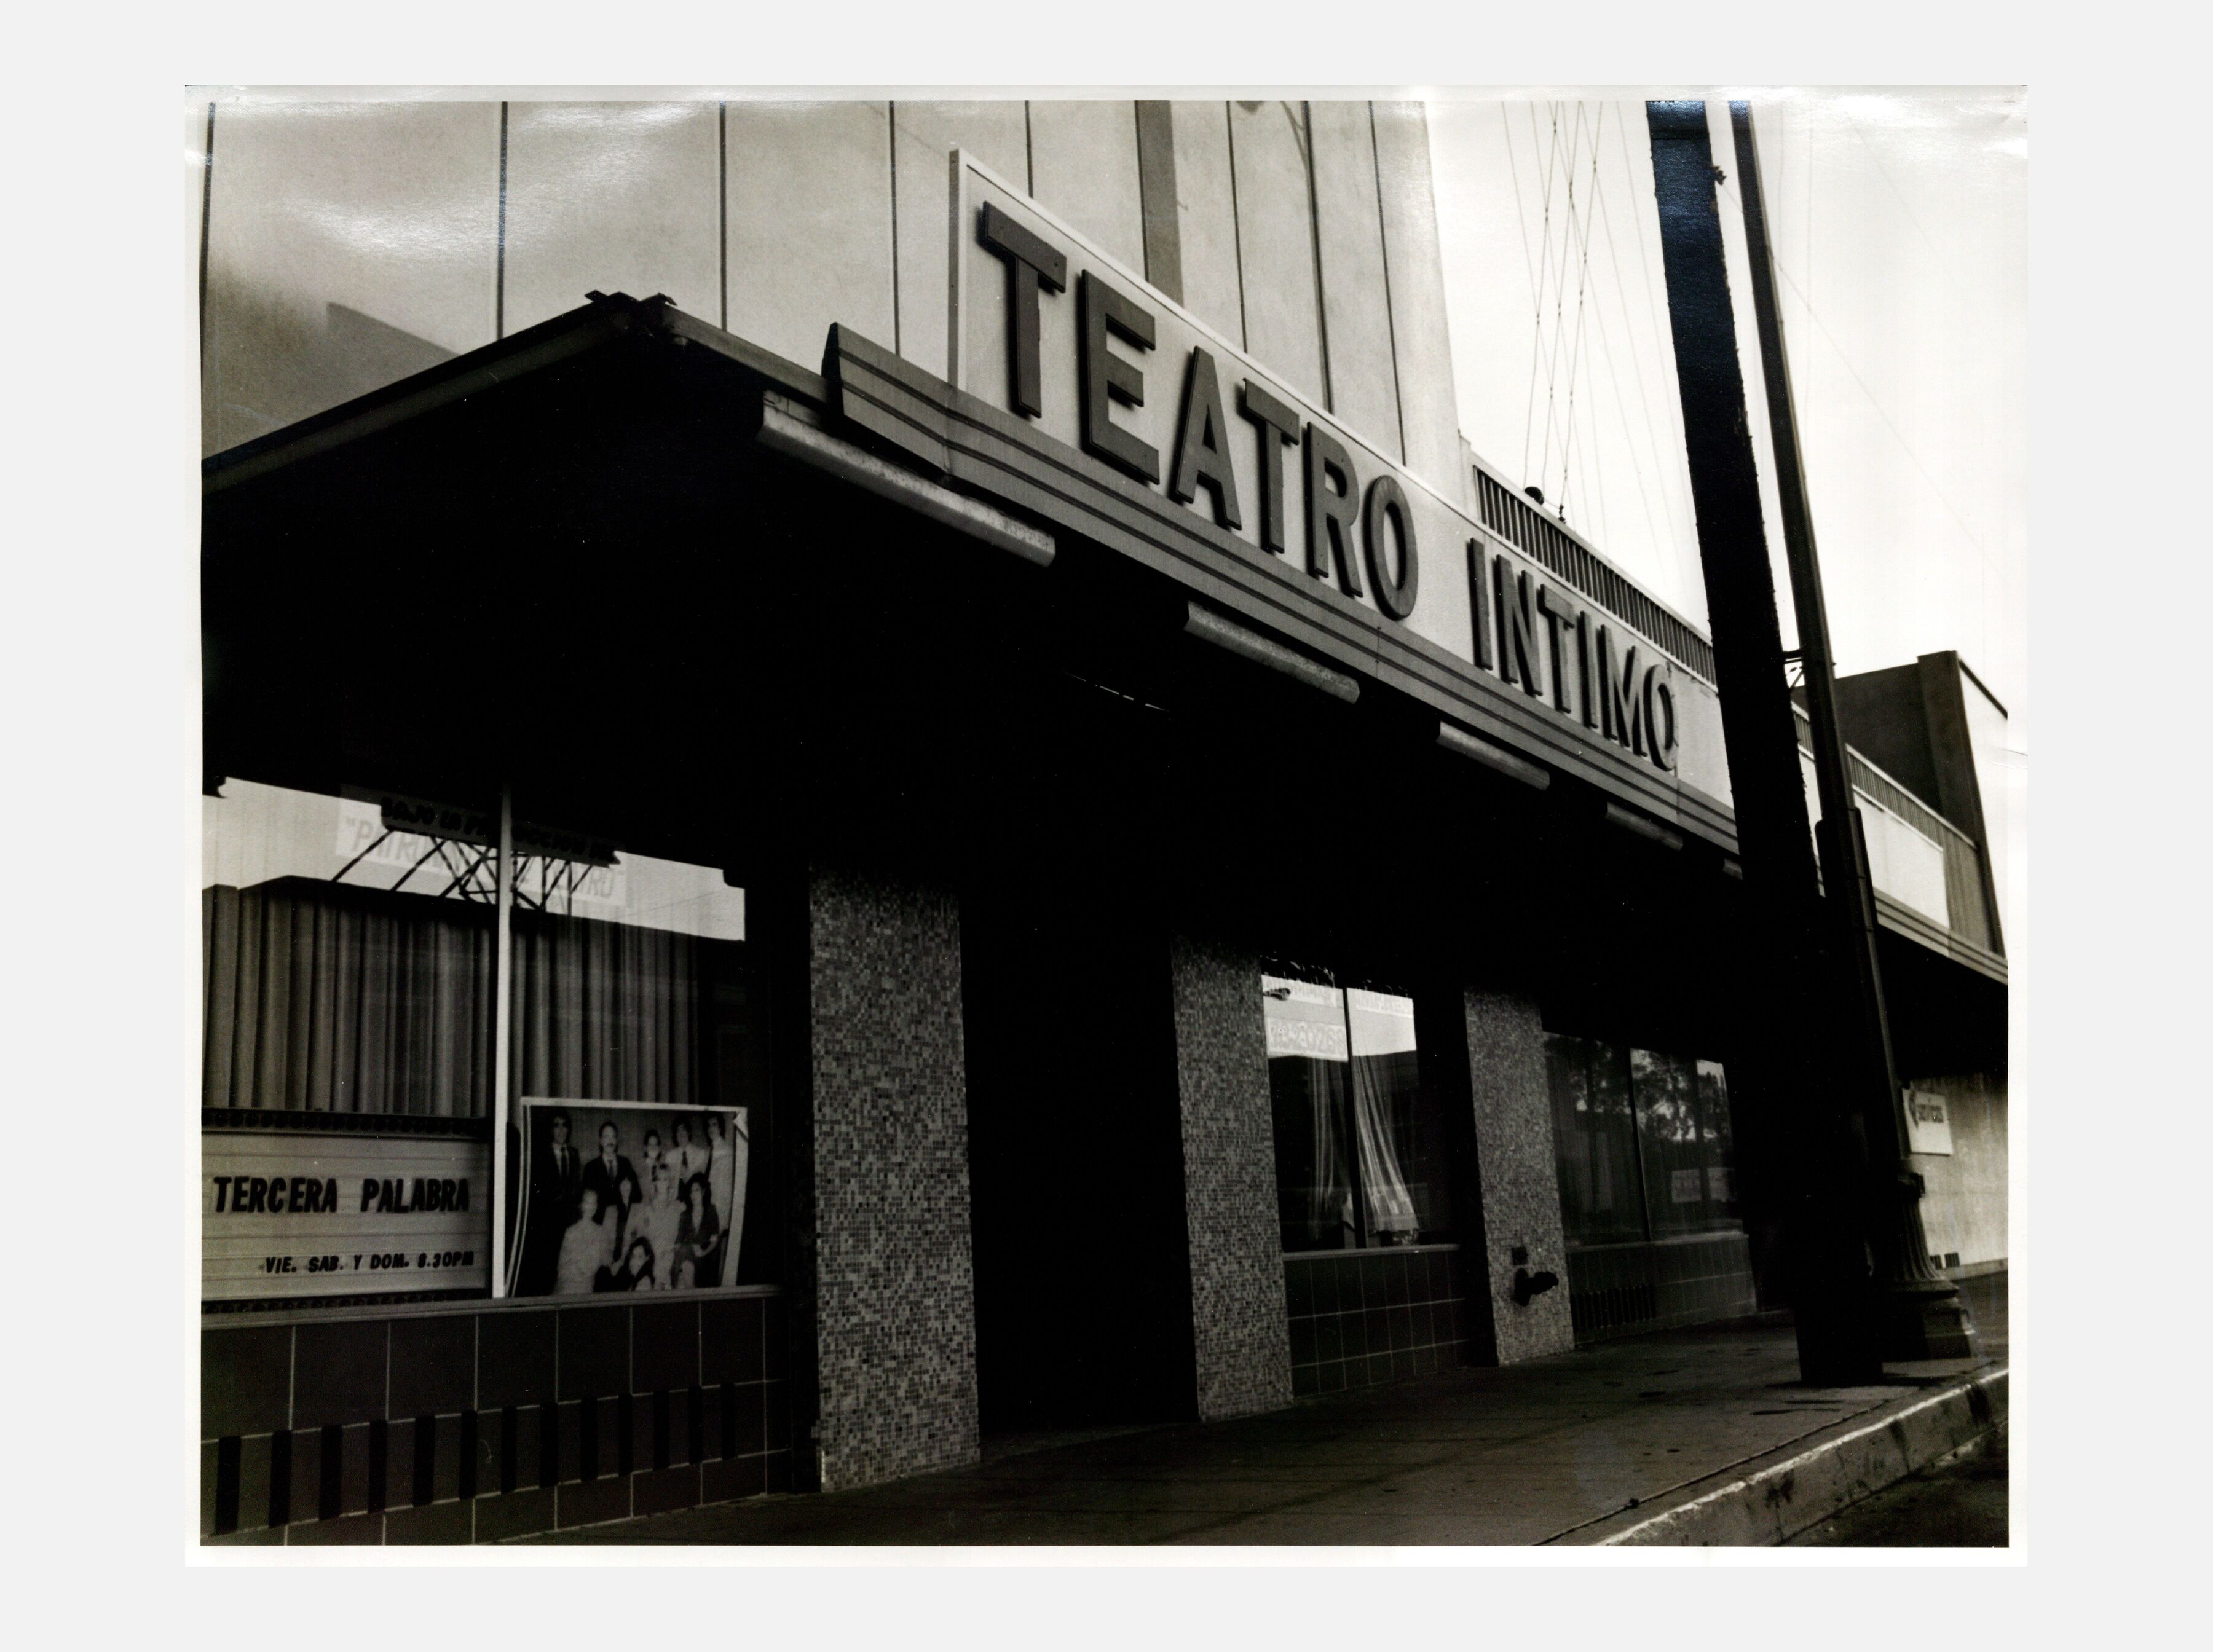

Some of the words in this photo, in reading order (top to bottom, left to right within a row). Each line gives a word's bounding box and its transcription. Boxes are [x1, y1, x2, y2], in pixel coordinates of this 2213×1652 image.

[977, 201, 1418, 618] TEATRO
[1468, 538, 1679, 771] INTIMO
[213, 1176, 337, 1213] TERCERA
[360, 1178, 469, 1213] PALABRA
[266, 1257, 297, 1273] VIE.
[308, 1256, 344, 1272] SAB.
[353, 1254, 363, 1270] Y
[370, 1253, 409, 1270] DOM.
